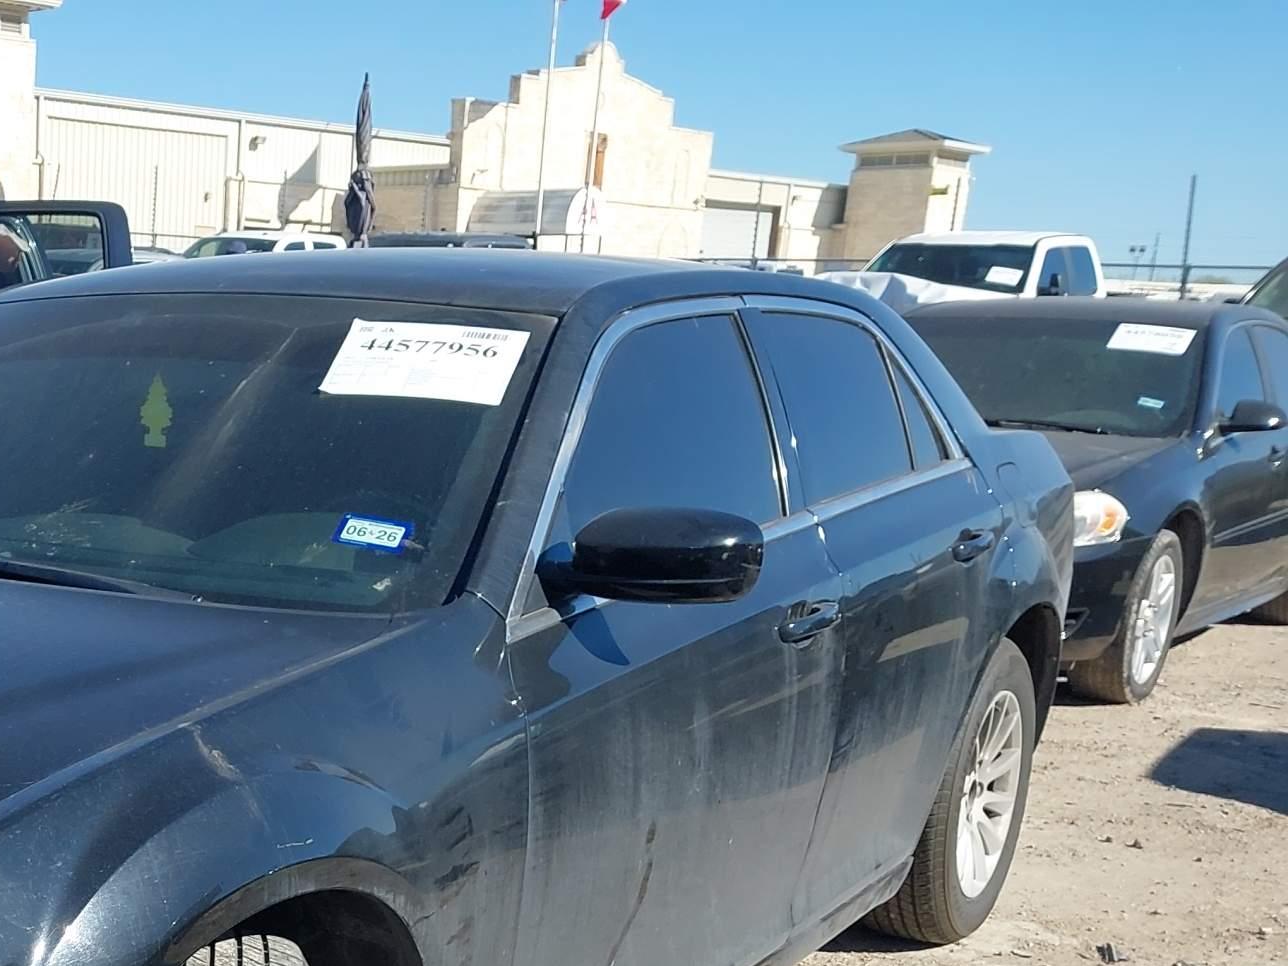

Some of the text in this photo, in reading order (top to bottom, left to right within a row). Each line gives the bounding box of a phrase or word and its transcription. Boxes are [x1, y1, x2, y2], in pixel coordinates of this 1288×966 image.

[359, 337, 499, 360] 44577956
[345, 524, 399, 543] 06 26
